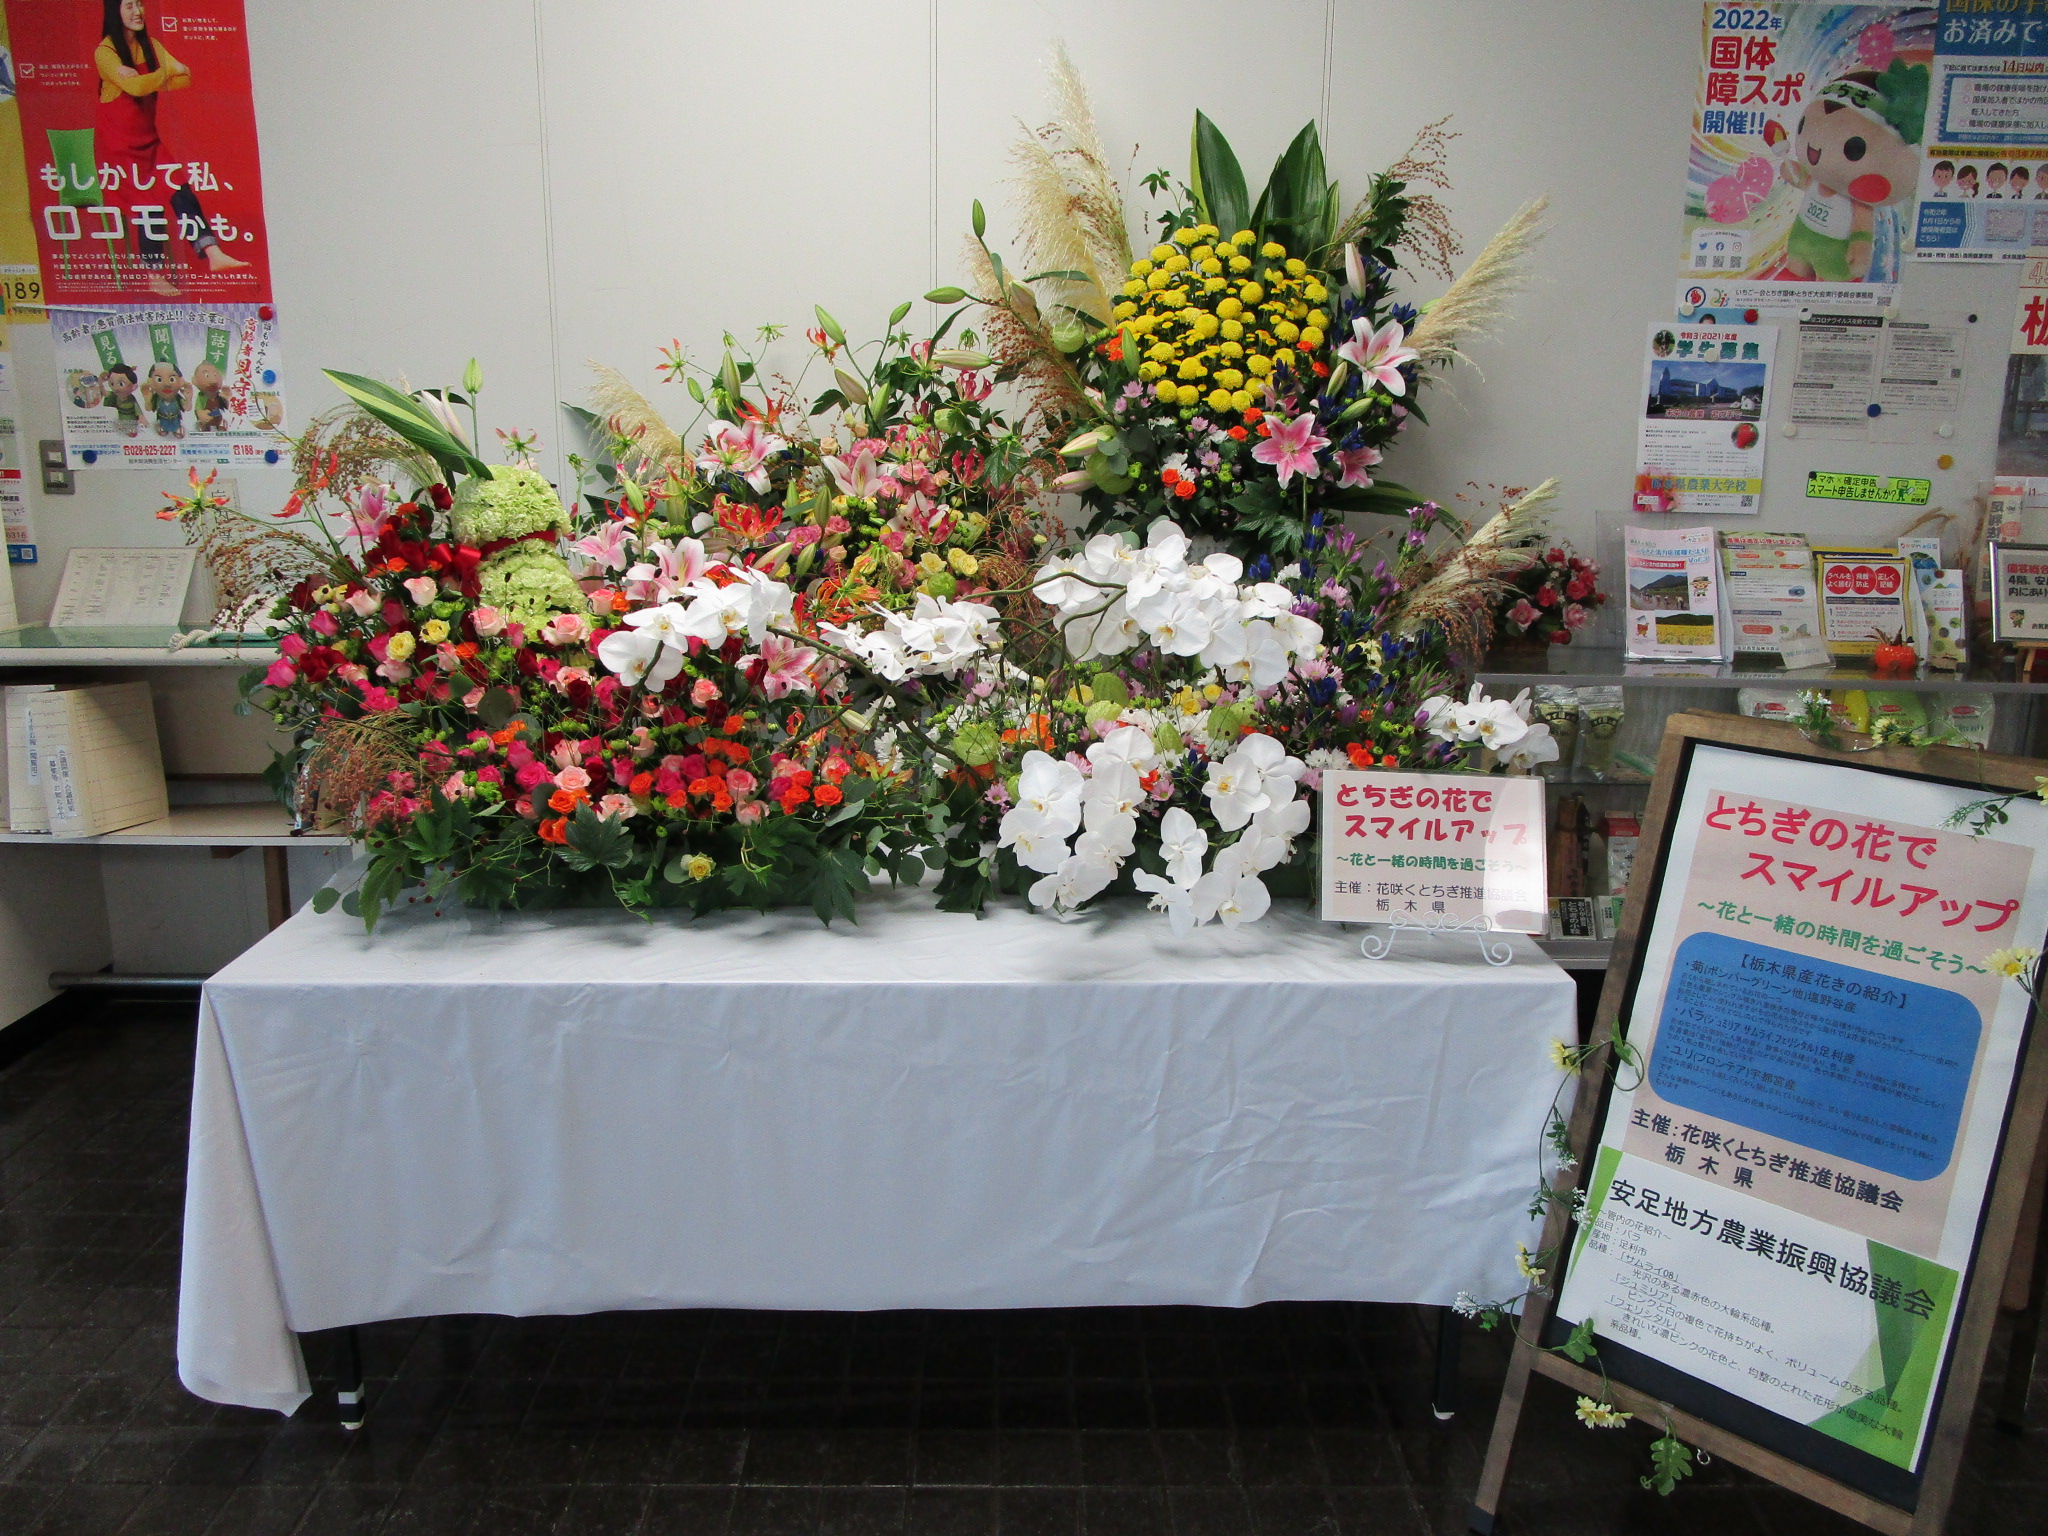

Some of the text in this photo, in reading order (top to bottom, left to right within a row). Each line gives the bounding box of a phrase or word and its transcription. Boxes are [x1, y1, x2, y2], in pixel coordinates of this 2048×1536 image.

[1712, 9, 1782, 30] 2022年
[1710, 36, 1776, 71] 国体
[1706, 71, 1805, 106] 障スポ
[1703, 110, 1765, 134] 開催!!
[40, 161, 234, 191] もしかして私、
[43, 205, 254, 242] ロコモかも。
[1807, 203, 1829, 222] 2022
[4, 282, 40, 299] 189
[61, 311, 226, 343] 高齢者の悪質商法被害防止!! 合言葉は
[1680, 331, 1738, 341] 令和3(2021)年度
[100, 335, 117, 364] 見る
[156, 329, 171, 361] 聞く
[211, 333, 226, 364] 話す
[241, 445, 254, 456] 188
[1808, 484, 1897, 500] スマート申告しませんか?
[2008, 575, 2048, 586] 4階、安
[1830, 620, 1835, 628] 2
[1336, 784, 1492, 812] とちぎの花で
[1345, 815, 1528, 845] スマイルアップ
[1706, 796, 1937, 869] とちぎの花で
[1740, 852, 2020, 932] スマイルアップ
[1741, 952, 1907, 1009] 【栃木県産花きの紹介】
[1610, 1180, 1935, 1320] 安足地方農業振興協議会
[1632, 1269, 1775, 1333] 光沢のある濃赤色の大輪系品種。
[1610, 1319, 1641, 1340] 系品種。
